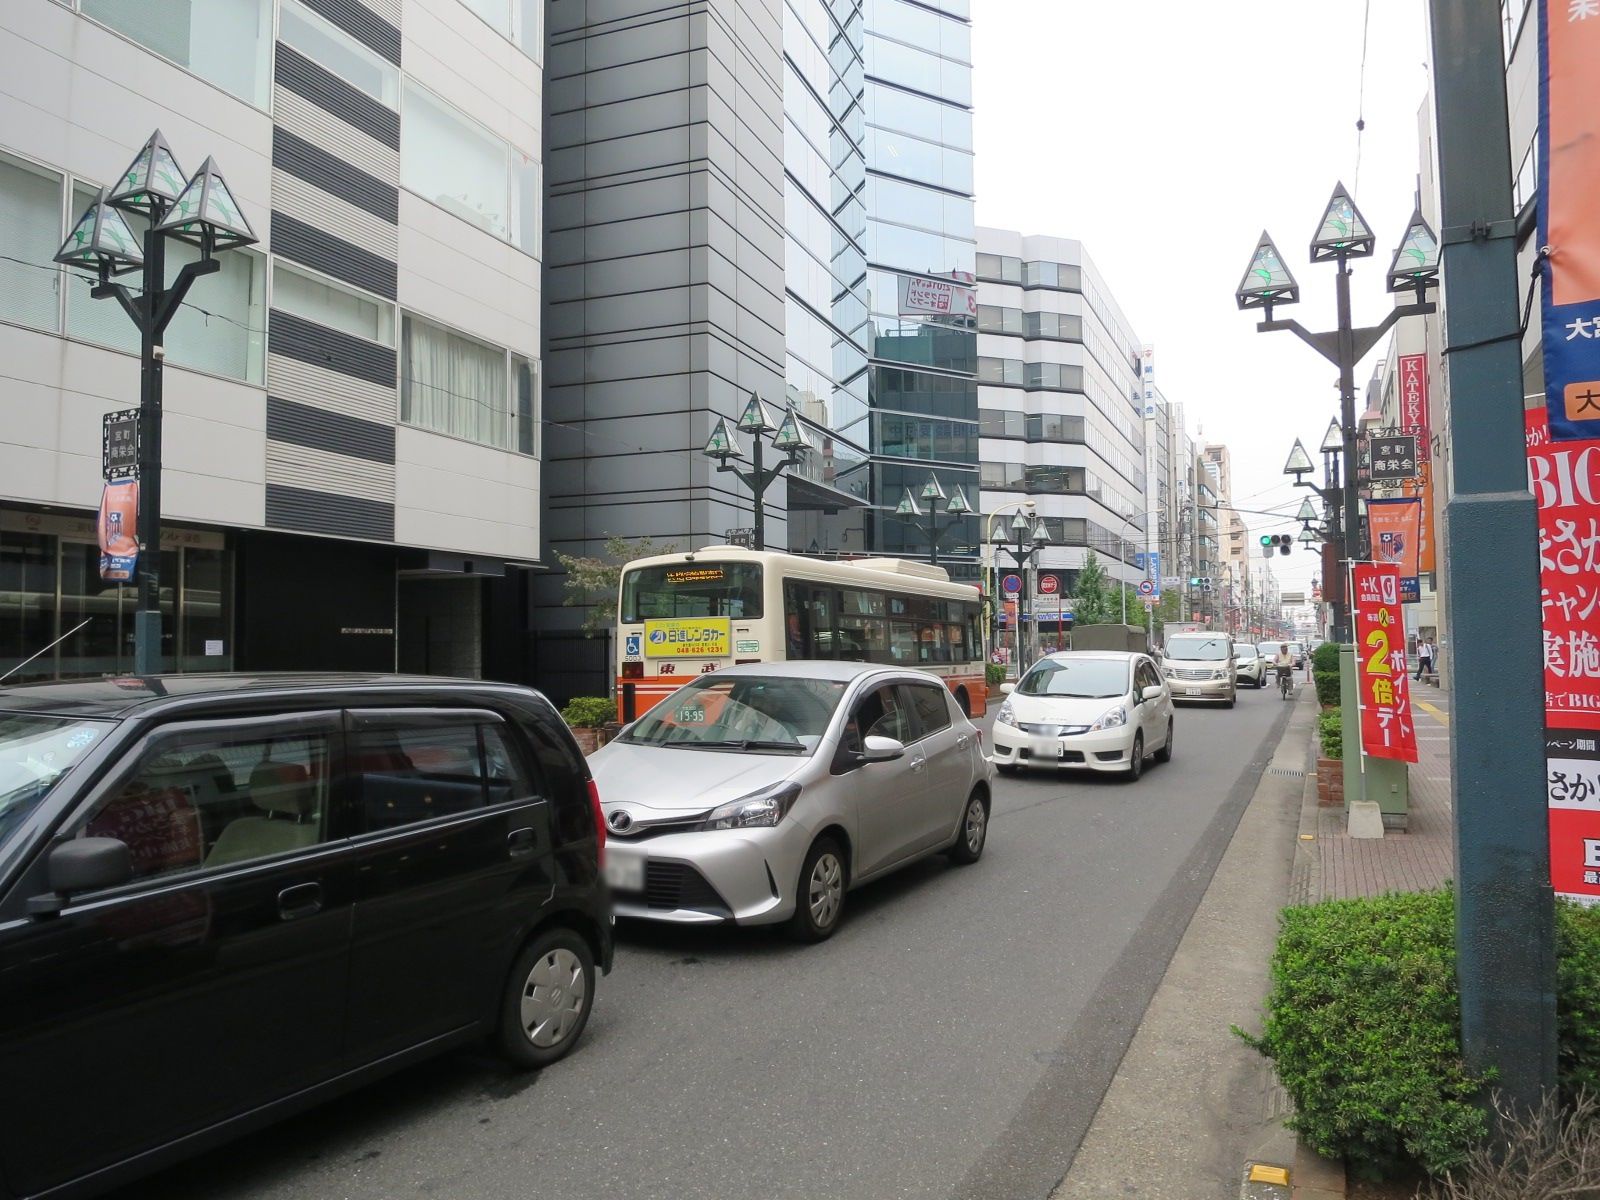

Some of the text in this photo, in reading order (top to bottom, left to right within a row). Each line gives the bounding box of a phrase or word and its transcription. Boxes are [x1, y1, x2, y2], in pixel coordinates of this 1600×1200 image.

[1381, 445, 1406, 456] 宮町
[1374, 459, 1415, 471] 商栄会
[668, 628, 725, 643] 日進レンタカー
[1391, 649, 1410, 738] ポイント
